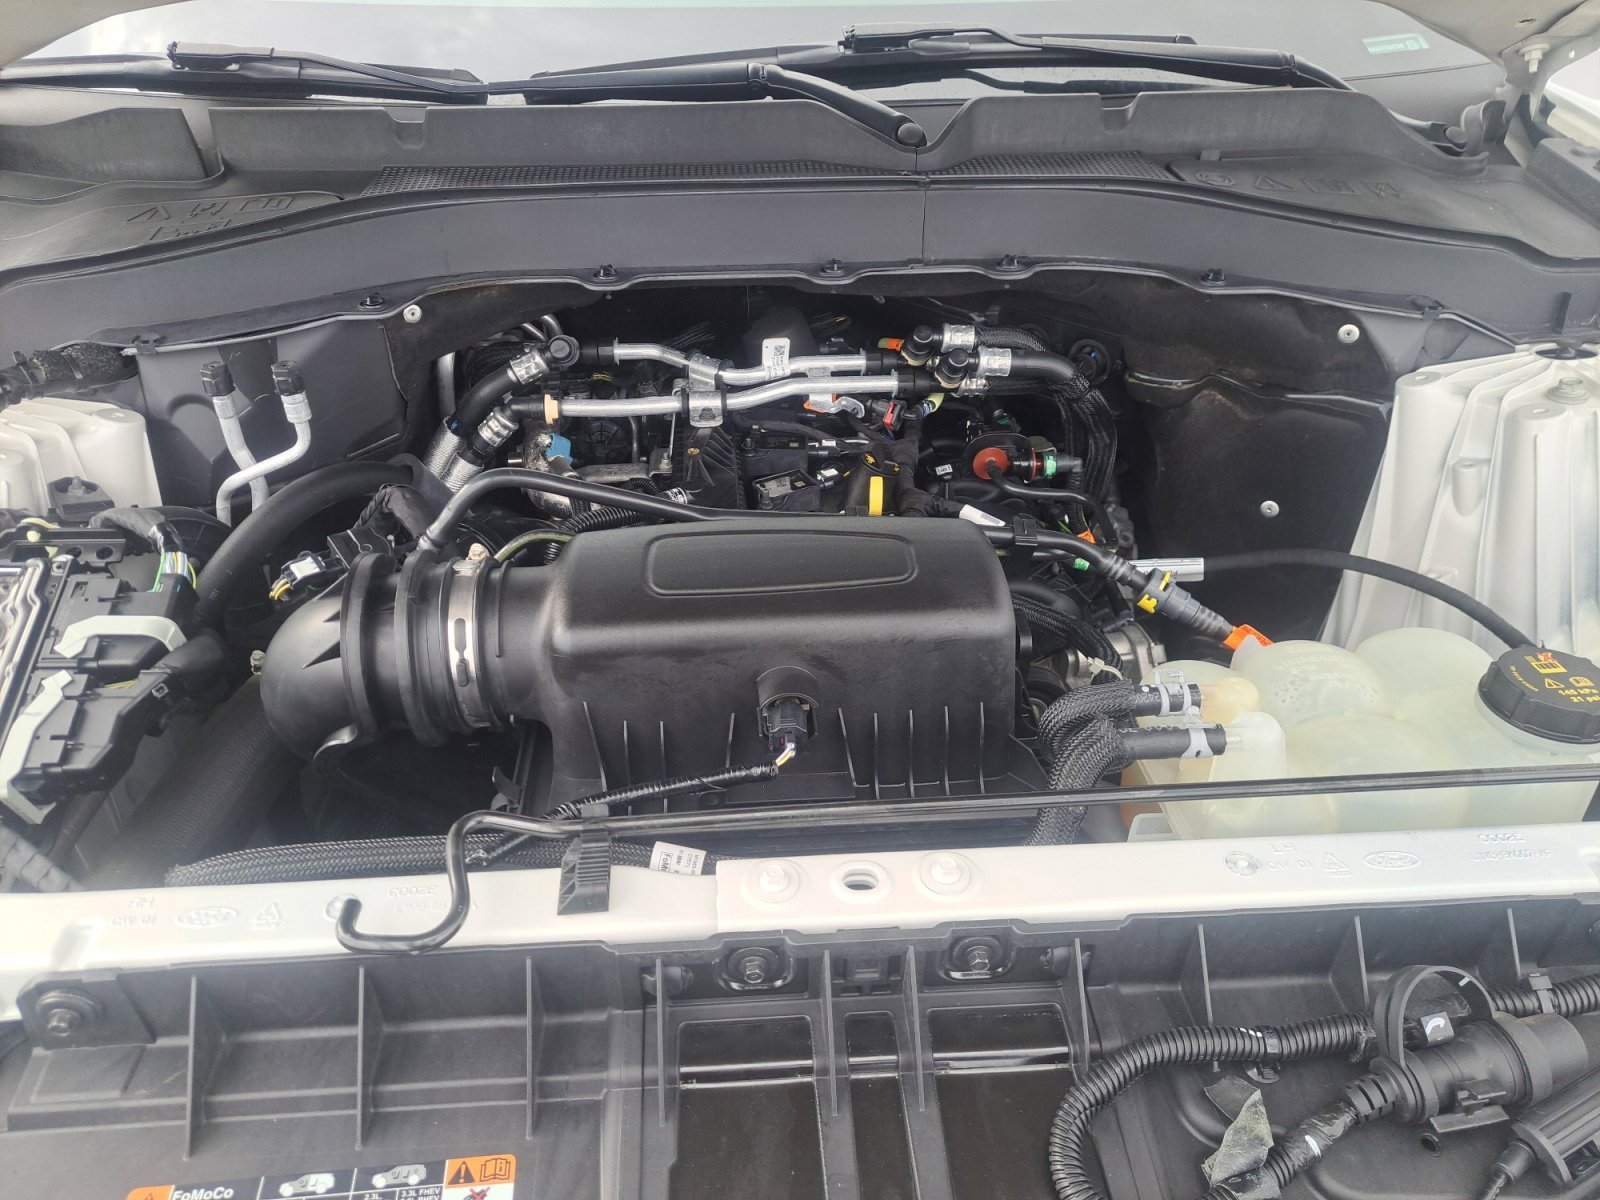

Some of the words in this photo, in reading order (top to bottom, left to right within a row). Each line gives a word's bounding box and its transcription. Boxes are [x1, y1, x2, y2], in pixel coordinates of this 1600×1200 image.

[172, 1186, 234, 1200] FoMoCo
[401, 1189, 417, 1197] 3.3L
[419, 1187, 441, 1196] FHEV
